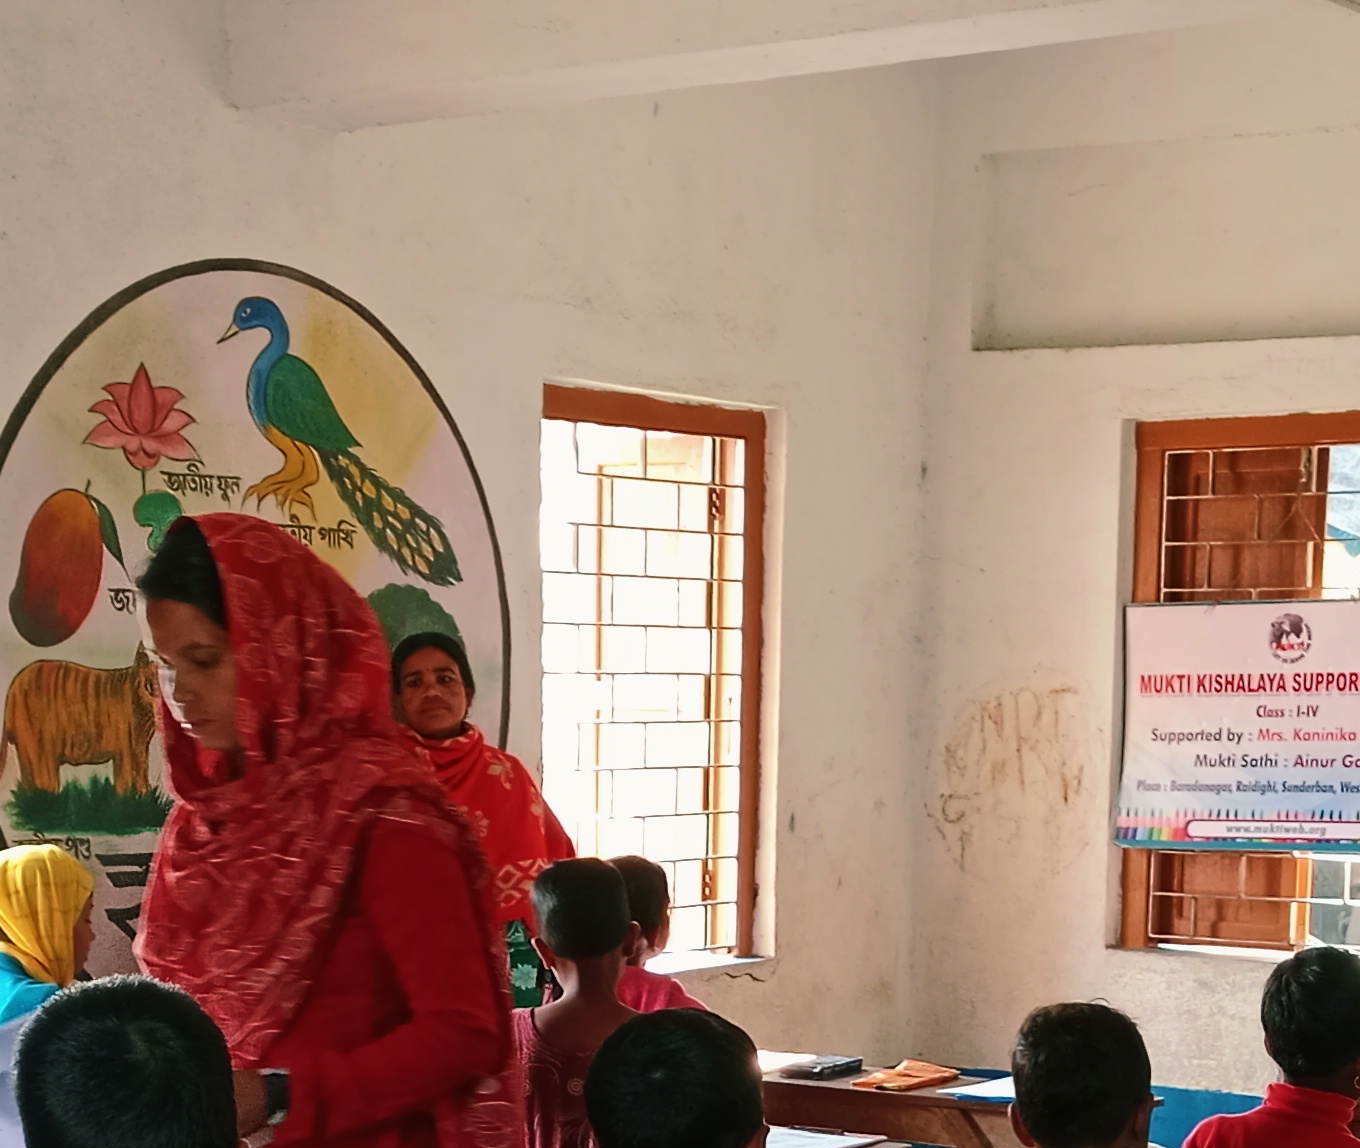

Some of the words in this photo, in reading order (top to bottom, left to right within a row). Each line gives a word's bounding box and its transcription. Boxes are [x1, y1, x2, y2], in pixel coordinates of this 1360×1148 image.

[159, 462, 215, 497] জাতীয়
[1140, 674, 1191, 694] MUKTI
[1196, 673, 1288, 693] KISHALAYA
[1256, 705, 1285, 718] Class
[1296, 705, 1320, 718] I-IV
[1151, 728, 1223, 745] Supported
[1227, 728, 1244, 745] by
[1257, 728, 1288, 742] Mrs.
[1293, 727, 1357, 742] Kaninika
[1194, 753, 1237, 768] Mukti
[1241, 753, 1279, 768] Sathi
[1293, 753, 1337, 768] Ainur
[1136, 780, 1161, 792] Place
[1236, 780, 1279, 796] Raidighi,
[1226, 823, 1327, 836] www.muktiweb.org
